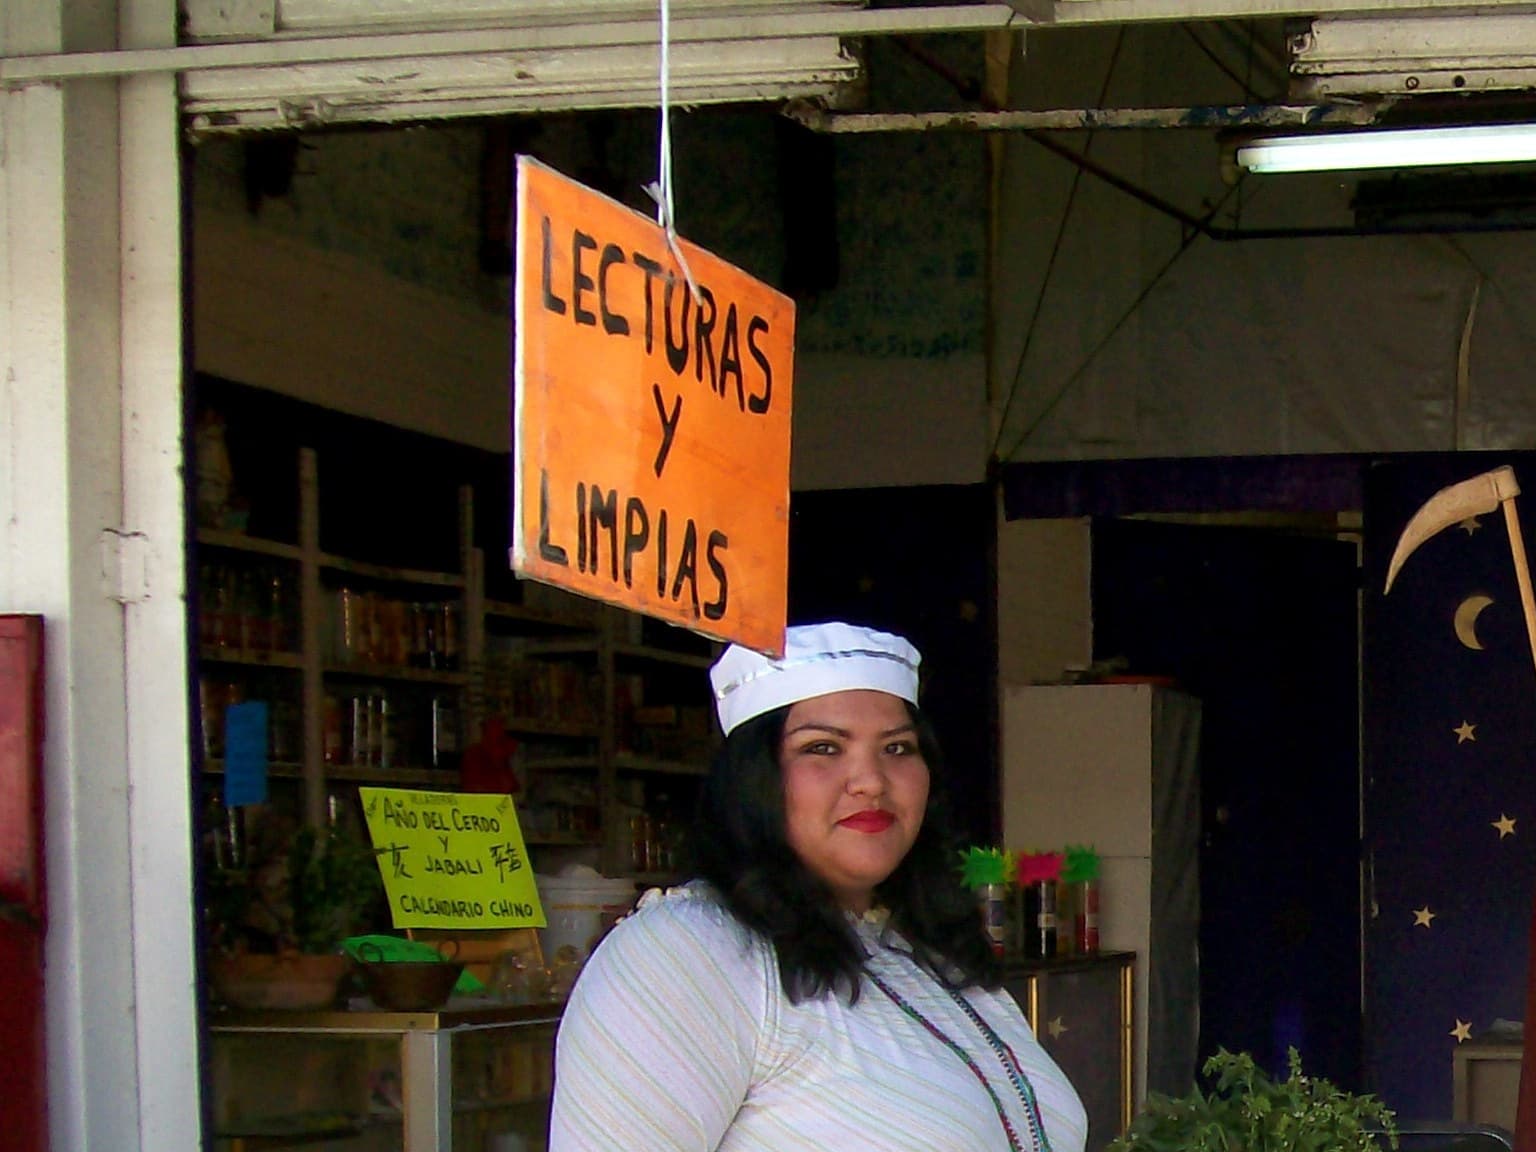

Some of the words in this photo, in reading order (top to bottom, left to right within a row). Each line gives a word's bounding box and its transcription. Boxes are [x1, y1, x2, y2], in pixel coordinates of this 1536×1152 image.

[540, 215, 773, 415] LECTURAS
[653, 382, 683, 478] Y
[538, 467, 729, 620] LIMPIAS
[423, 809, 450, 832] DEL
[451, 807, 501, 833] CERDO
[438, 835, 449, 853] Y
[424, 854, 484, 875] JABALI
[399, 894, 484, 919] CALENDARIO
[489, 899, 534, 918] CHINO
